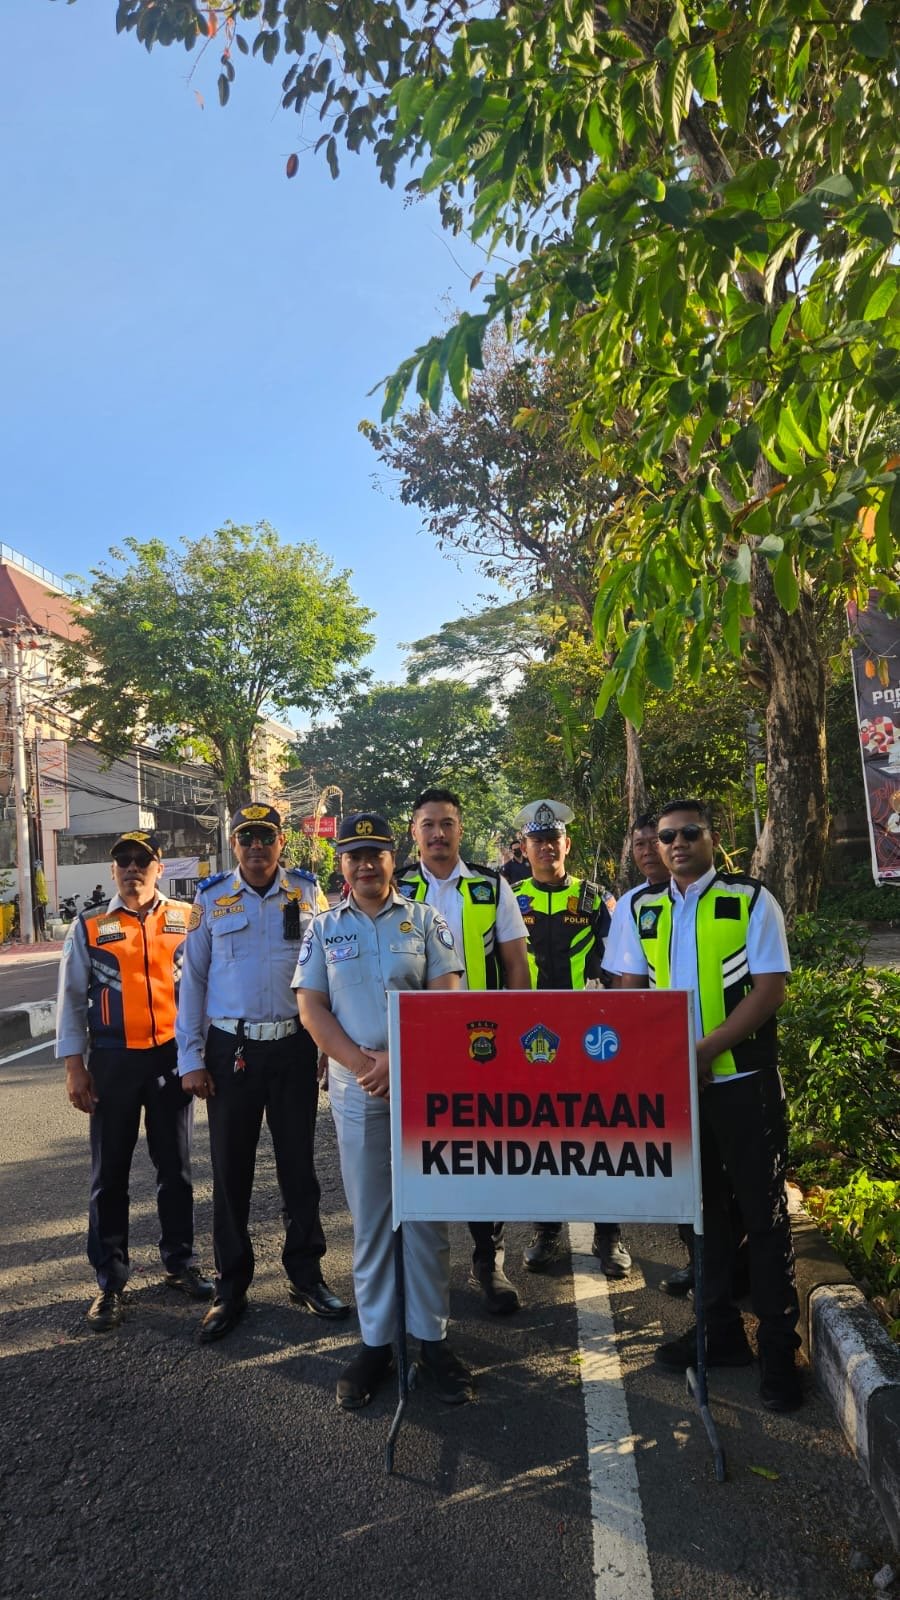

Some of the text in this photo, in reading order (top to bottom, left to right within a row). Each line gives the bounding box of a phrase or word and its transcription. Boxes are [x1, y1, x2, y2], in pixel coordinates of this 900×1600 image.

[564, 916, 588, 924] POLRI
[325, 934, 357, 945] NOVI
[426, 1093, 665, 1128] PENDATAAN
[421, 1140, 673, 1177] KENDARAAN
